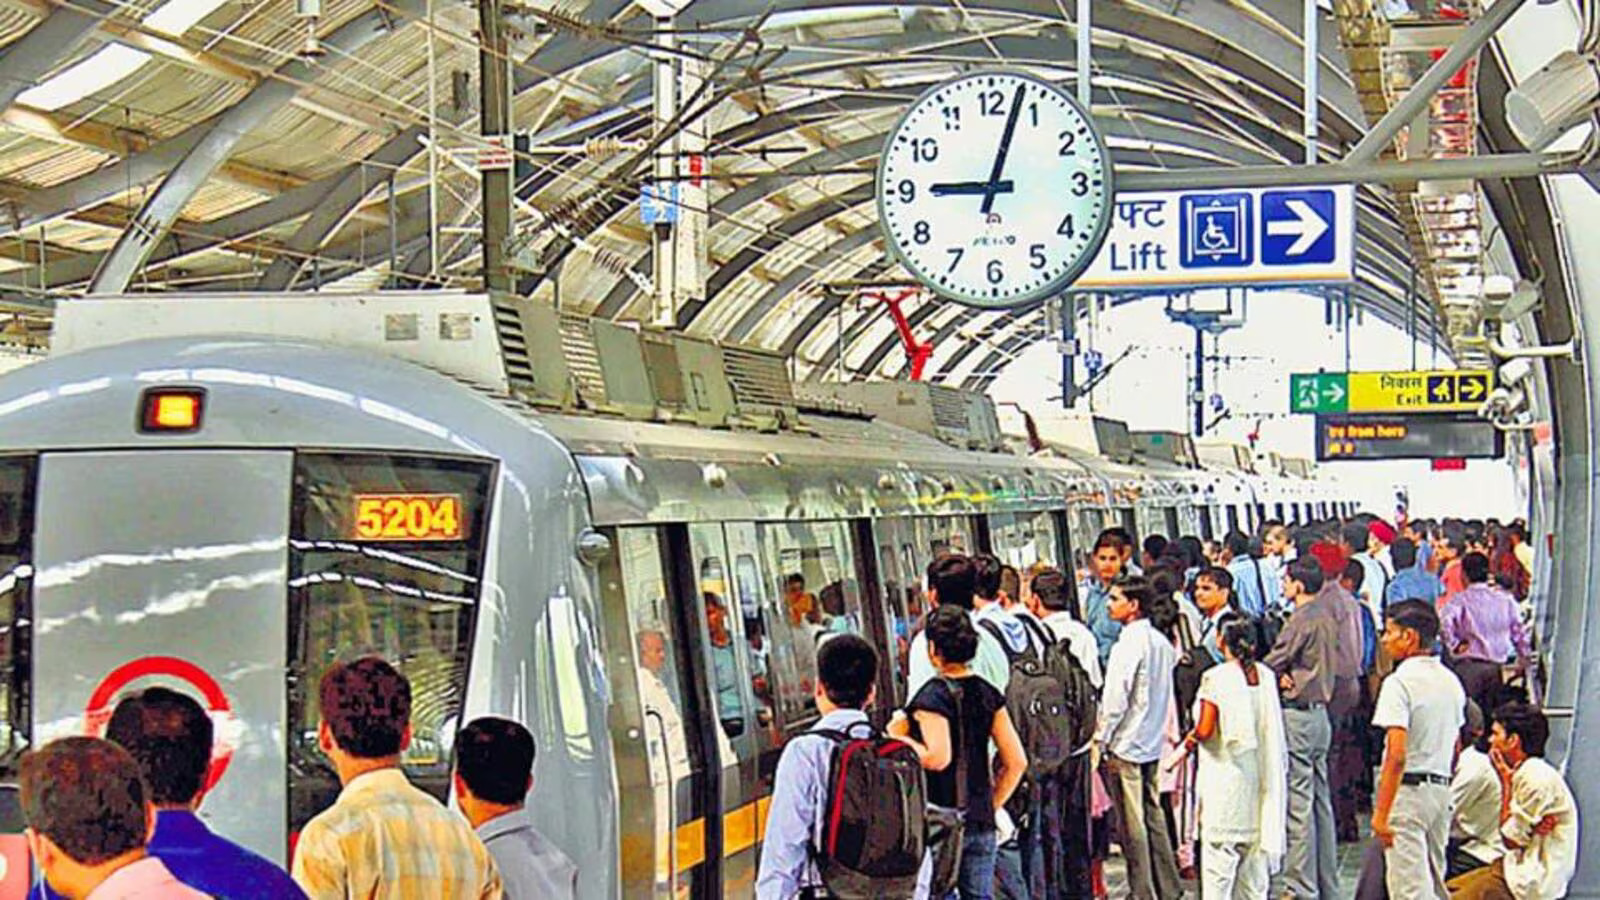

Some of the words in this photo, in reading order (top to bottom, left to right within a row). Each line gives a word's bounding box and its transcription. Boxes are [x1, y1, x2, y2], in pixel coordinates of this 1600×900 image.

[978, 91, 1005, 116] 12
[1028, 102, 1038, 127] 1
[942, 106, 960, 131] 11
[910, 138, 938, 163] 10
[1058, 131, 1075, 157] 2
[898, 179, 915, 204] 9
[1071, 172, 1089, 197] 3
[1057, 214, 1074, 239] 4
[1113, 200, 1167, 228] फ्ट
[913, 220, 930, 245] 8
[947, 248, 964, 274] 7
[1030, 244, 1046, 269] 5
[1110, 241, 1167, 271] Lift
[986, 260, 1004, 285] 6
[1396, 393, 1422, 406] Exit
[1347, 425, 1375, 438] from
[1377, 425, 1405, 438] here
[357, 497, 458, 538] 5204
